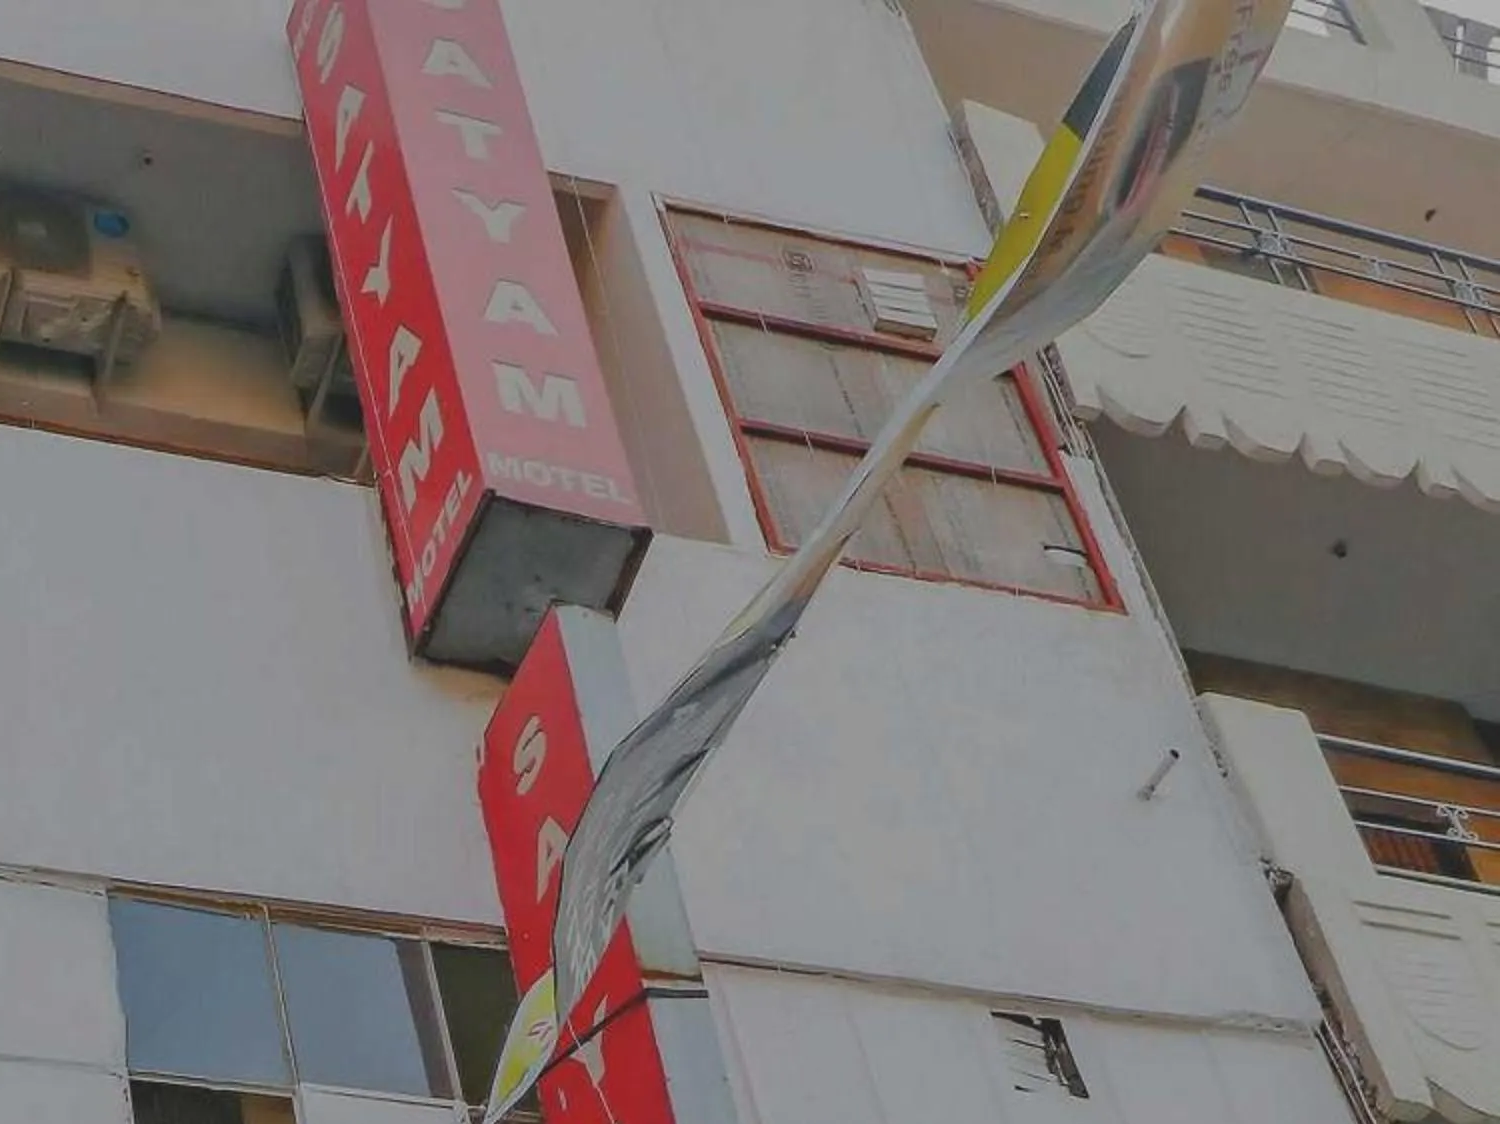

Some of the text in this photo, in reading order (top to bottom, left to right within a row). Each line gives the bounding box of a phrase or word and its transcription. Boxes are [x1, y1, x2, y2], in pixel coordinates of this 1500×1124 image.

[316, 2, 445, 515] SATYAM
[420, 0, 587, 429] ATYAM
[404, 469, 474, 615] MOTEL
[486, 451, 625, 500] MOTEL
